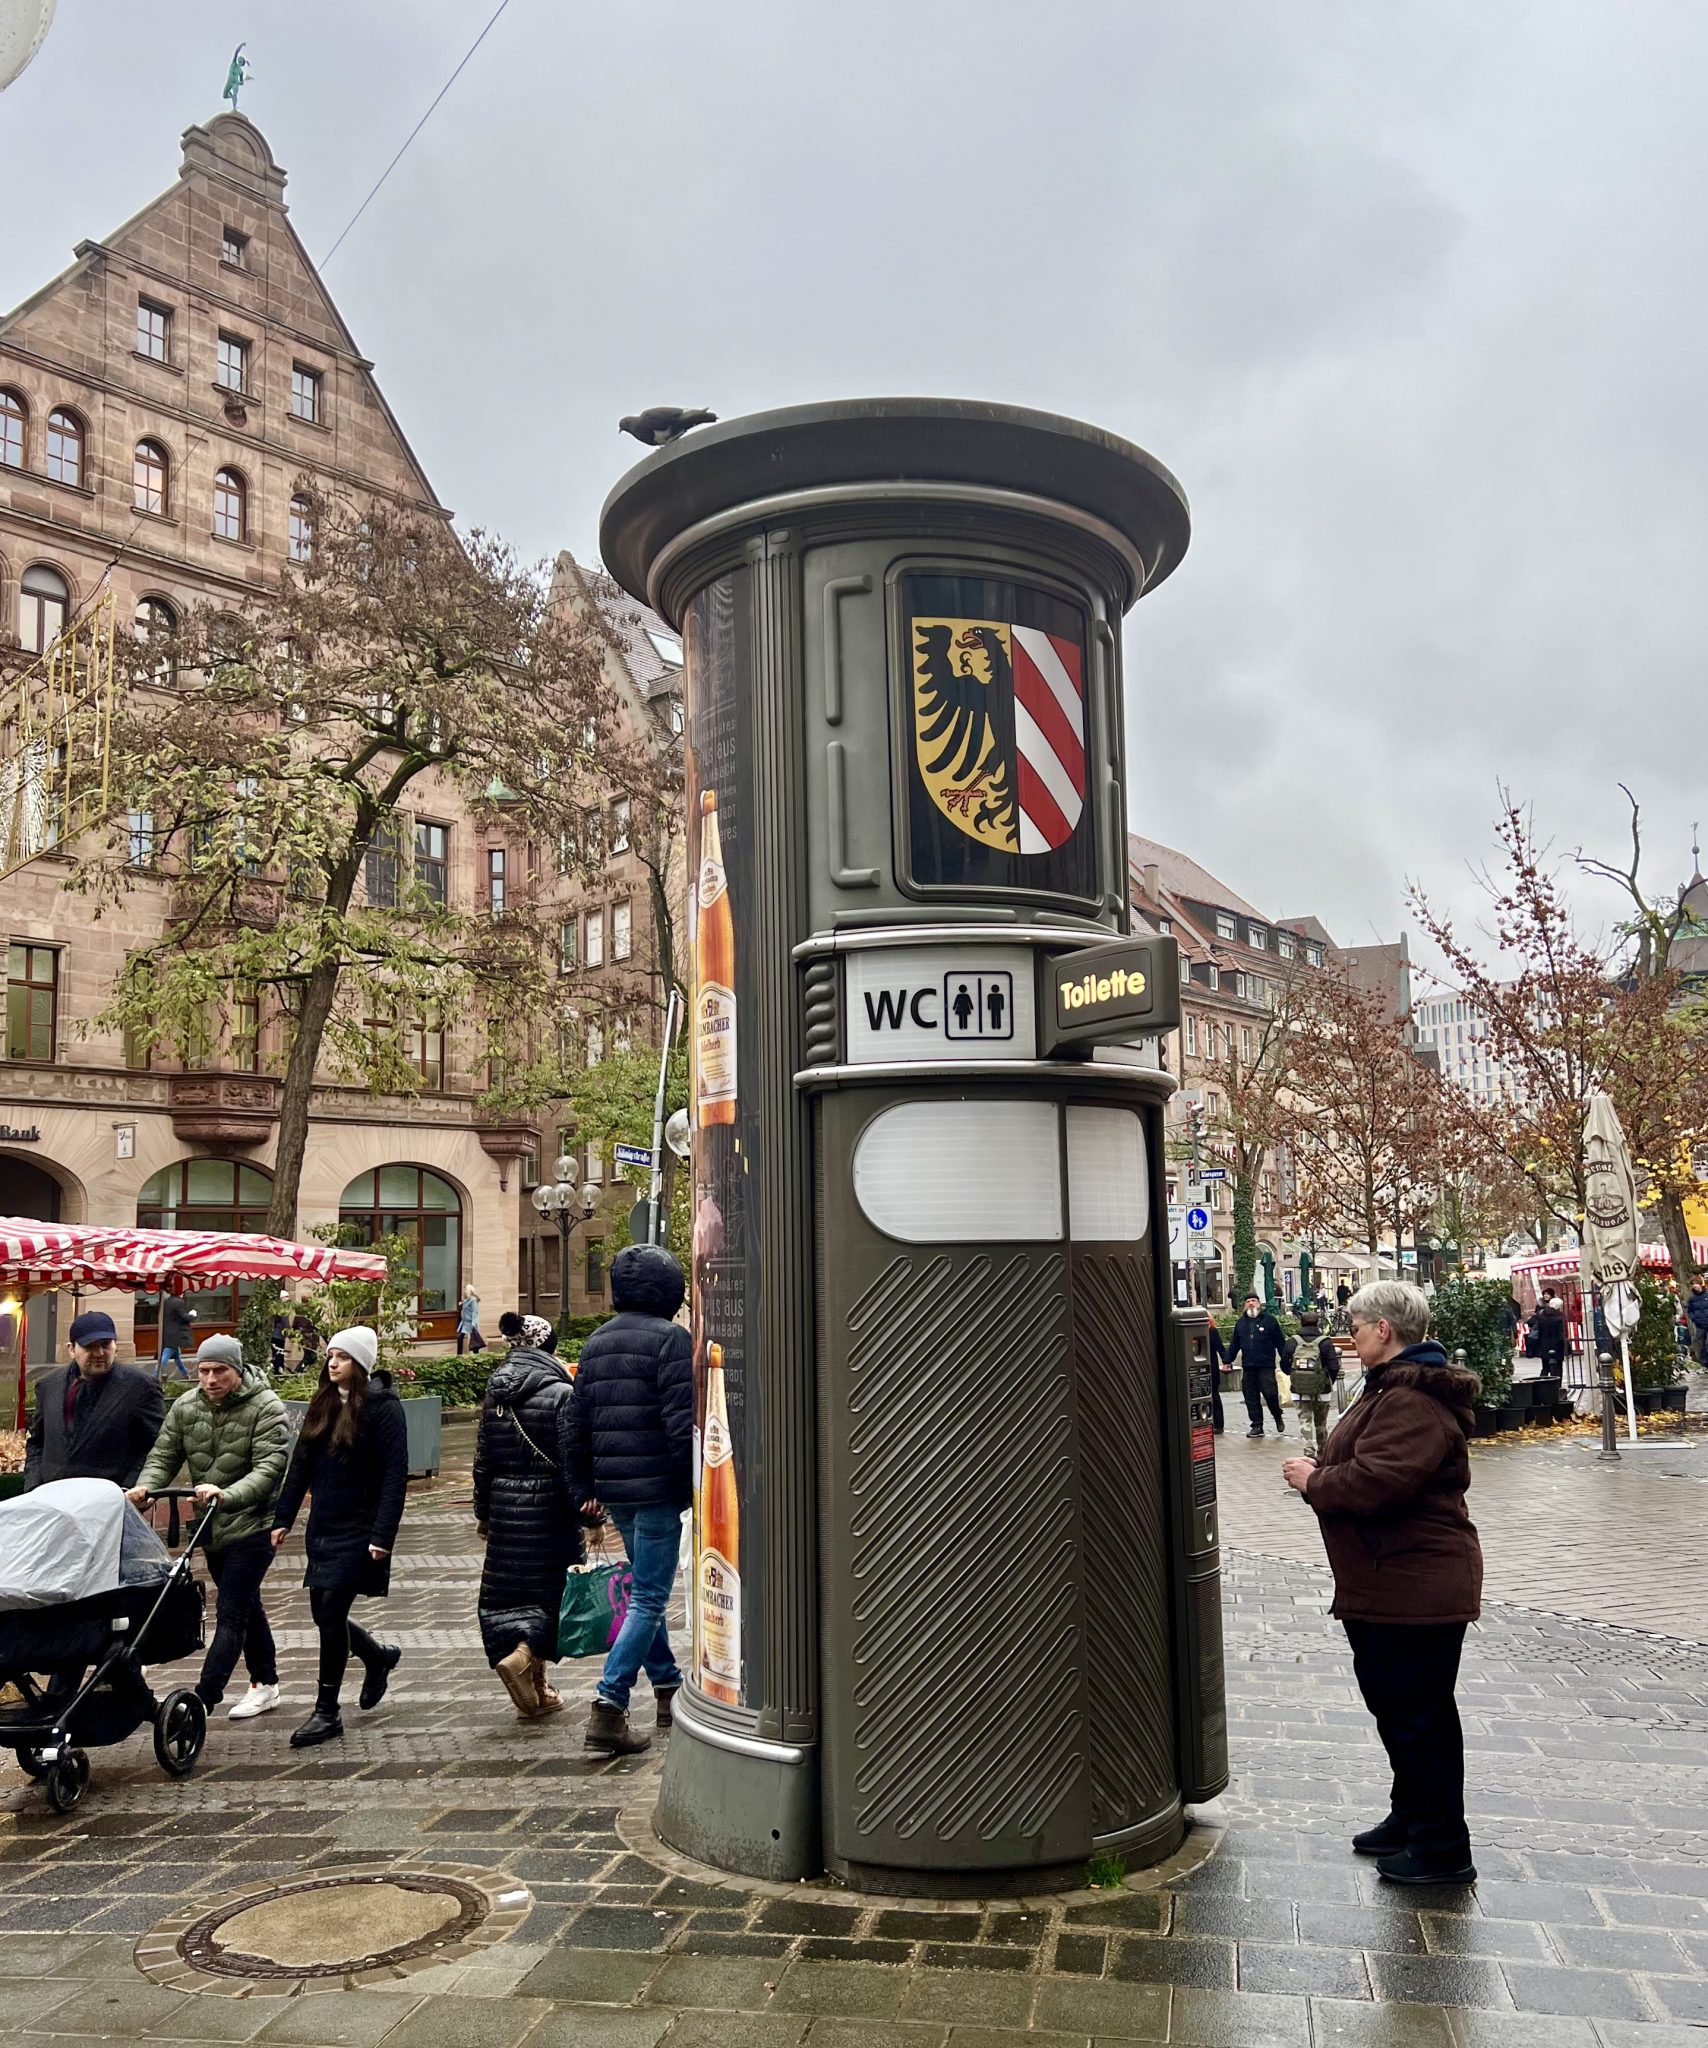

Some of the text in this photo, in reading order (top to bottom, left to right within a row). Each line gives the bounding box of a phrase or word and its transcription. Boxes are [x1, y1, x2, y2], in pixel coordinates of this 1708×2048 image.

[863, 988, 938, 1031] WC
[1060, 968, 1146, 1010] Toilette
[0, 1125, 41, 1141] Bank
